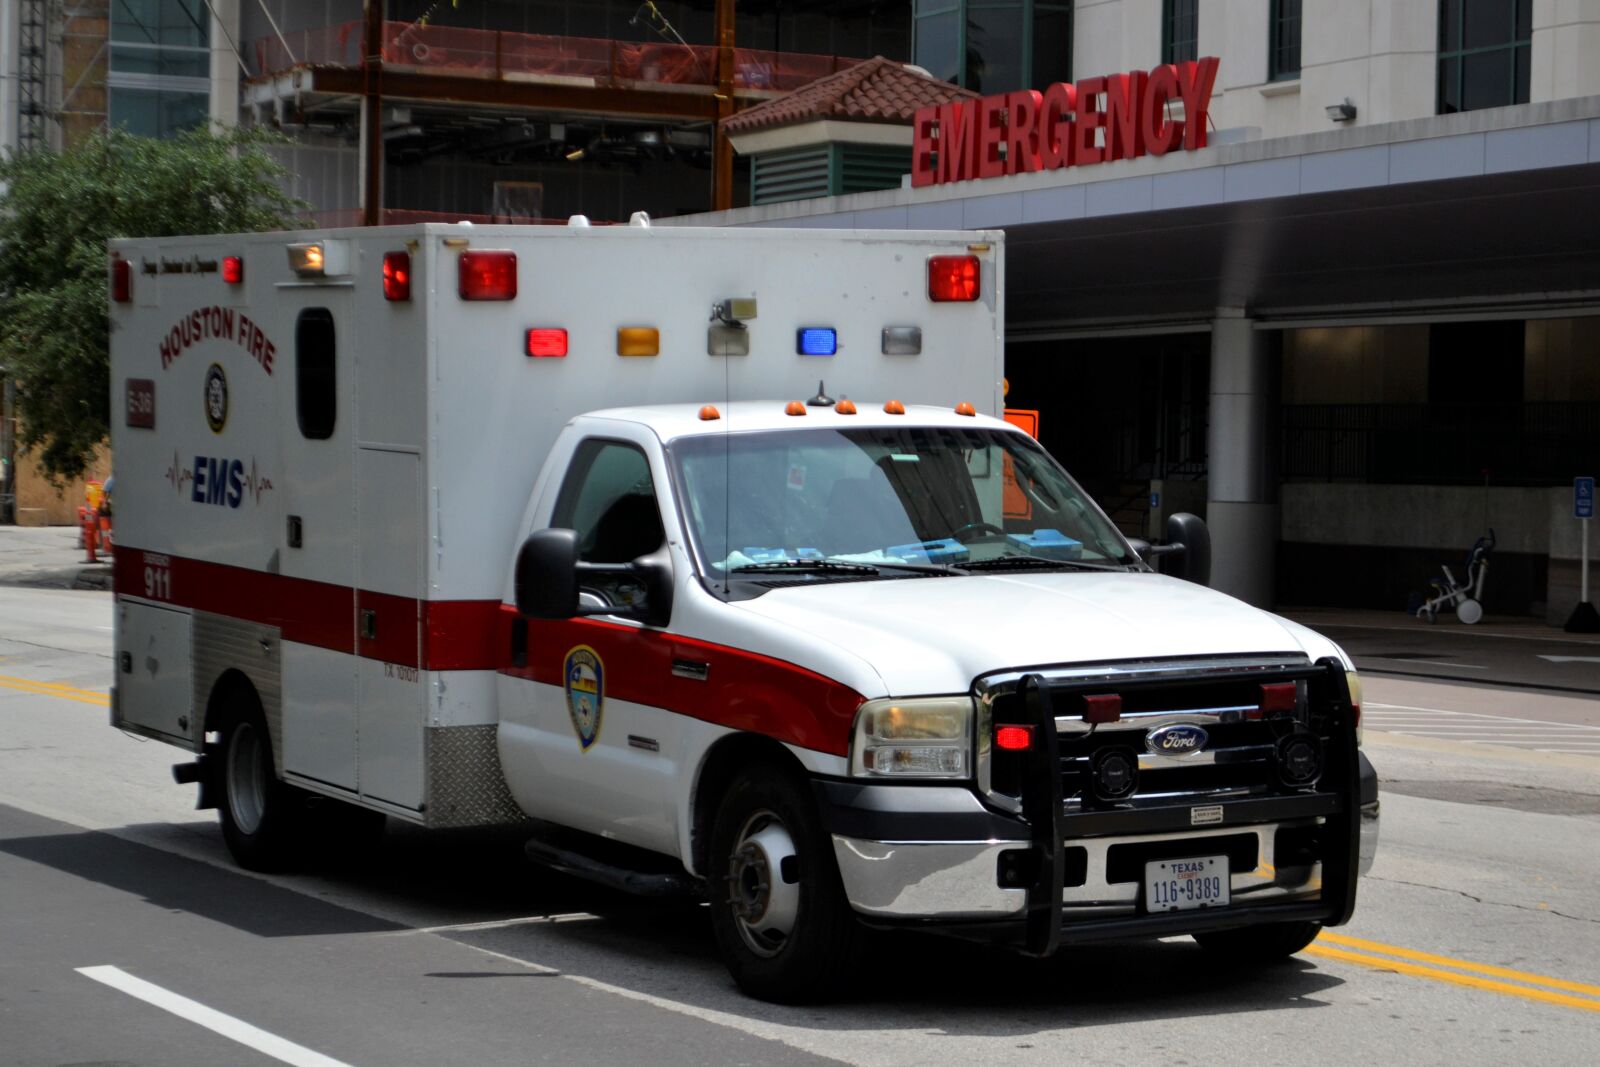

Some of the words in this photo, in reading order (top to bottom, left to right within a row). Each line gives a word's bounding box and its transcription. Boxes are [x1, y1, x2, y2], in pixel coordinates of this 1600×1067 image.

[911, 56, 1220, 188] EMERGENCY
[159, 305, 234, 370] HOUSTON
[238, 314, 277, 376] FIRE
[192, 456, 244, 509] EMS
[144, 566, 171, 600] 911
[384, 662, 394, 678] TX
[1163, 731, 1196, 749] Ford
[1171, 862, 1204, 874] TEXAS
